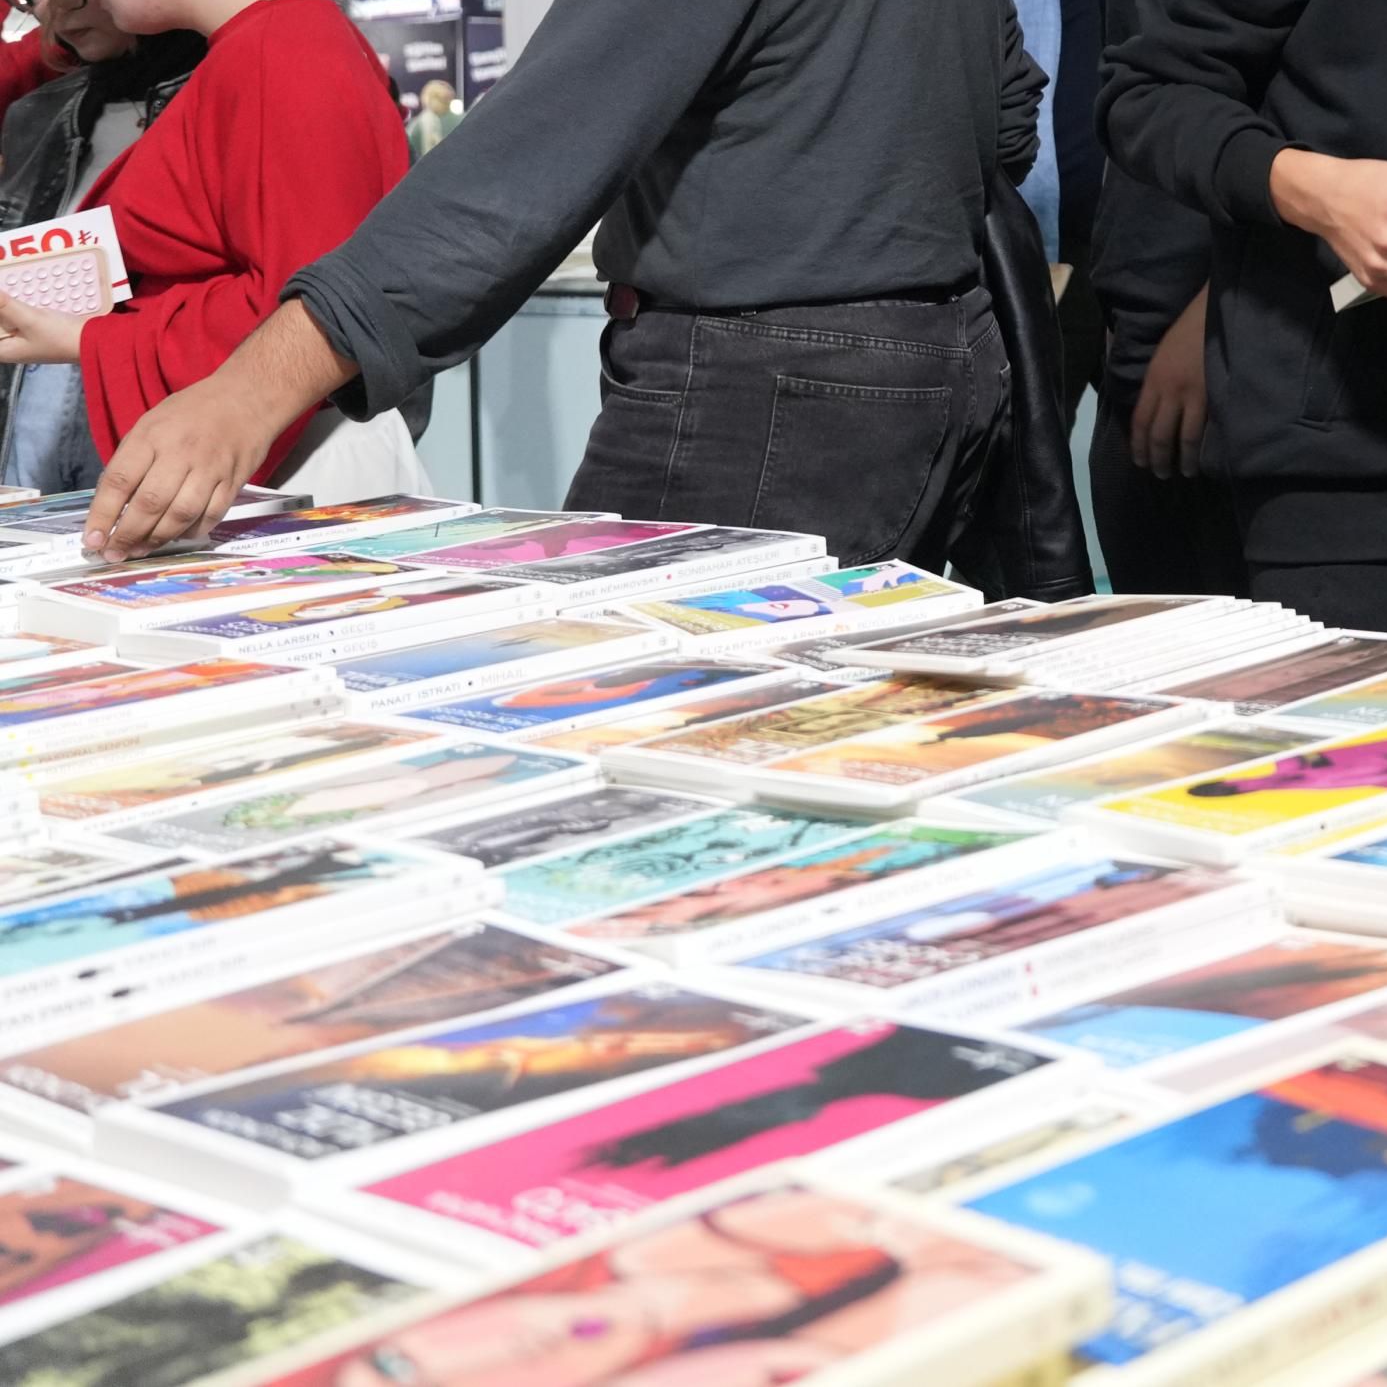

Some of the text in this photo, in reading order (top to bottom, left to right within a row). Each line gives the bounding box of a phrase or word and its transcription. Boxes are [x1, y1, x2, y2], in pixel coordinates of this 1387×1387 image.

[238, 641, 274, 655] NELLA
[276, 631, 321, 648] LARSEN
[371, 692, 412, 710] PANAIT
[417, 681, 462, 700] ISTRATI
